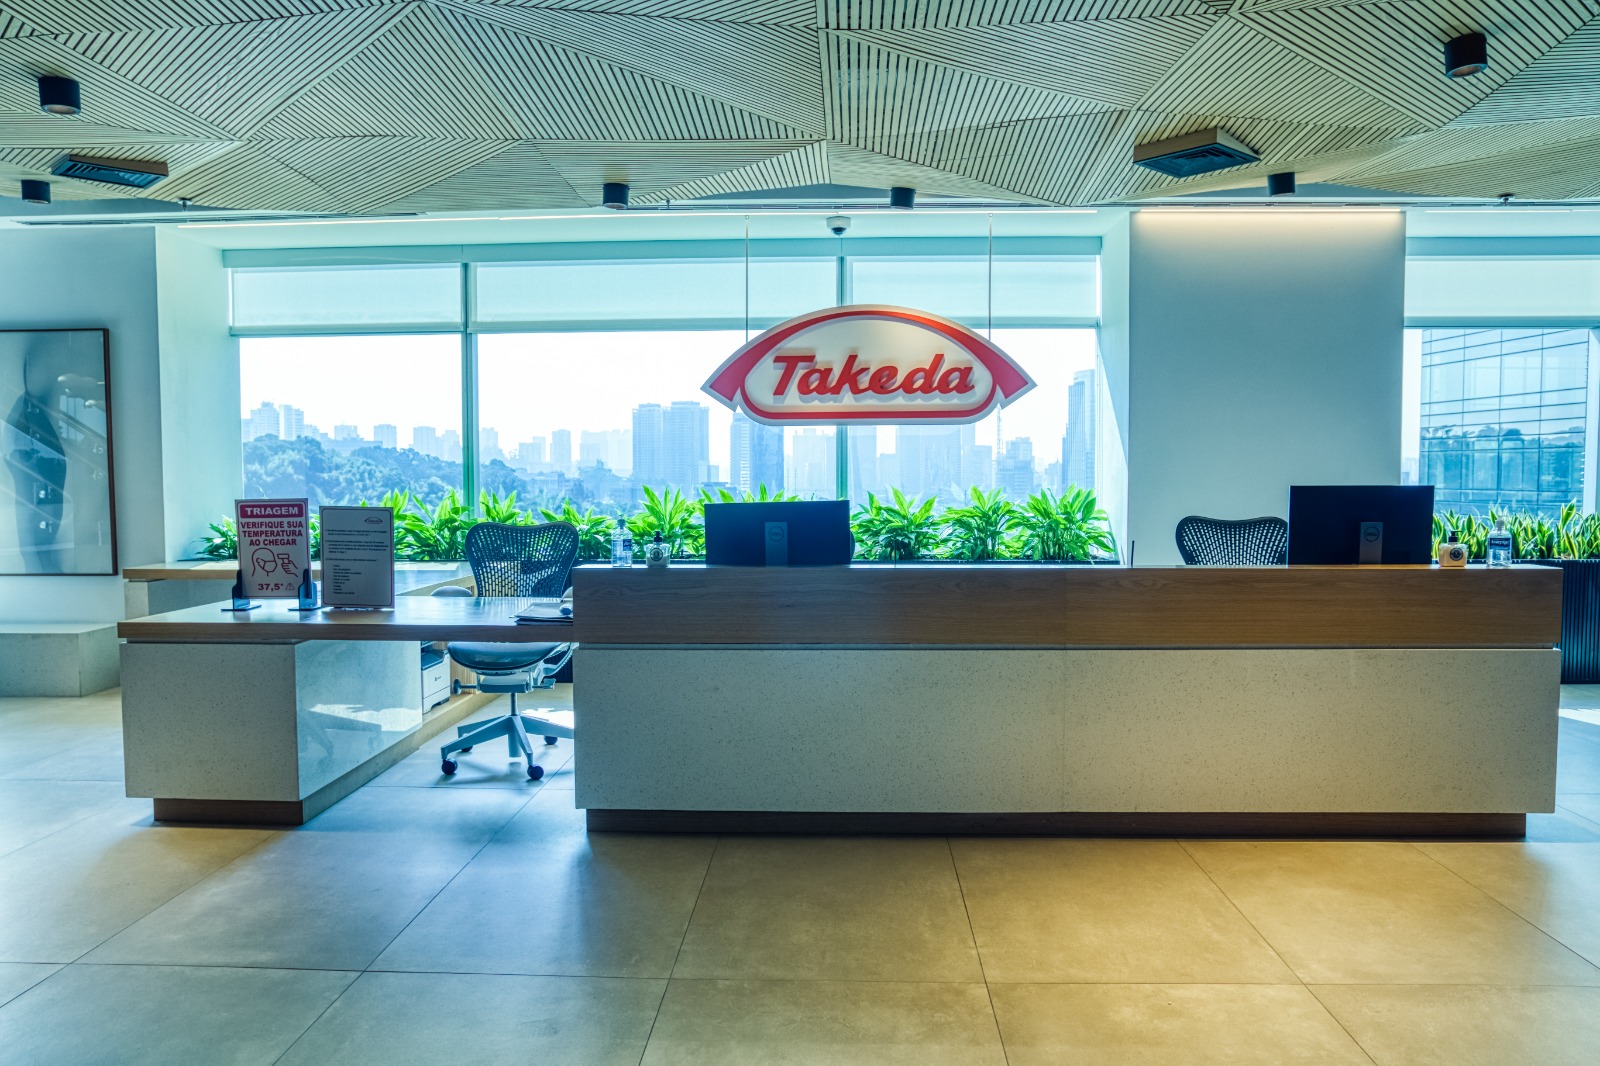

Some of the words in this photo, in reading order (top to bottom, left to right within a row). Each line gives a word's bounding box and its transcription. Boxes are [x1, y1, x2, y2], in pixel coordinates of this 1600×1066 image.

[772, 353, 975, 396] Takeda
[245, 507, 298, 515] TRIAGEM
[240, 521, 284, 529] VERIFIQUE
[286, 521, 303, 529] SUA
